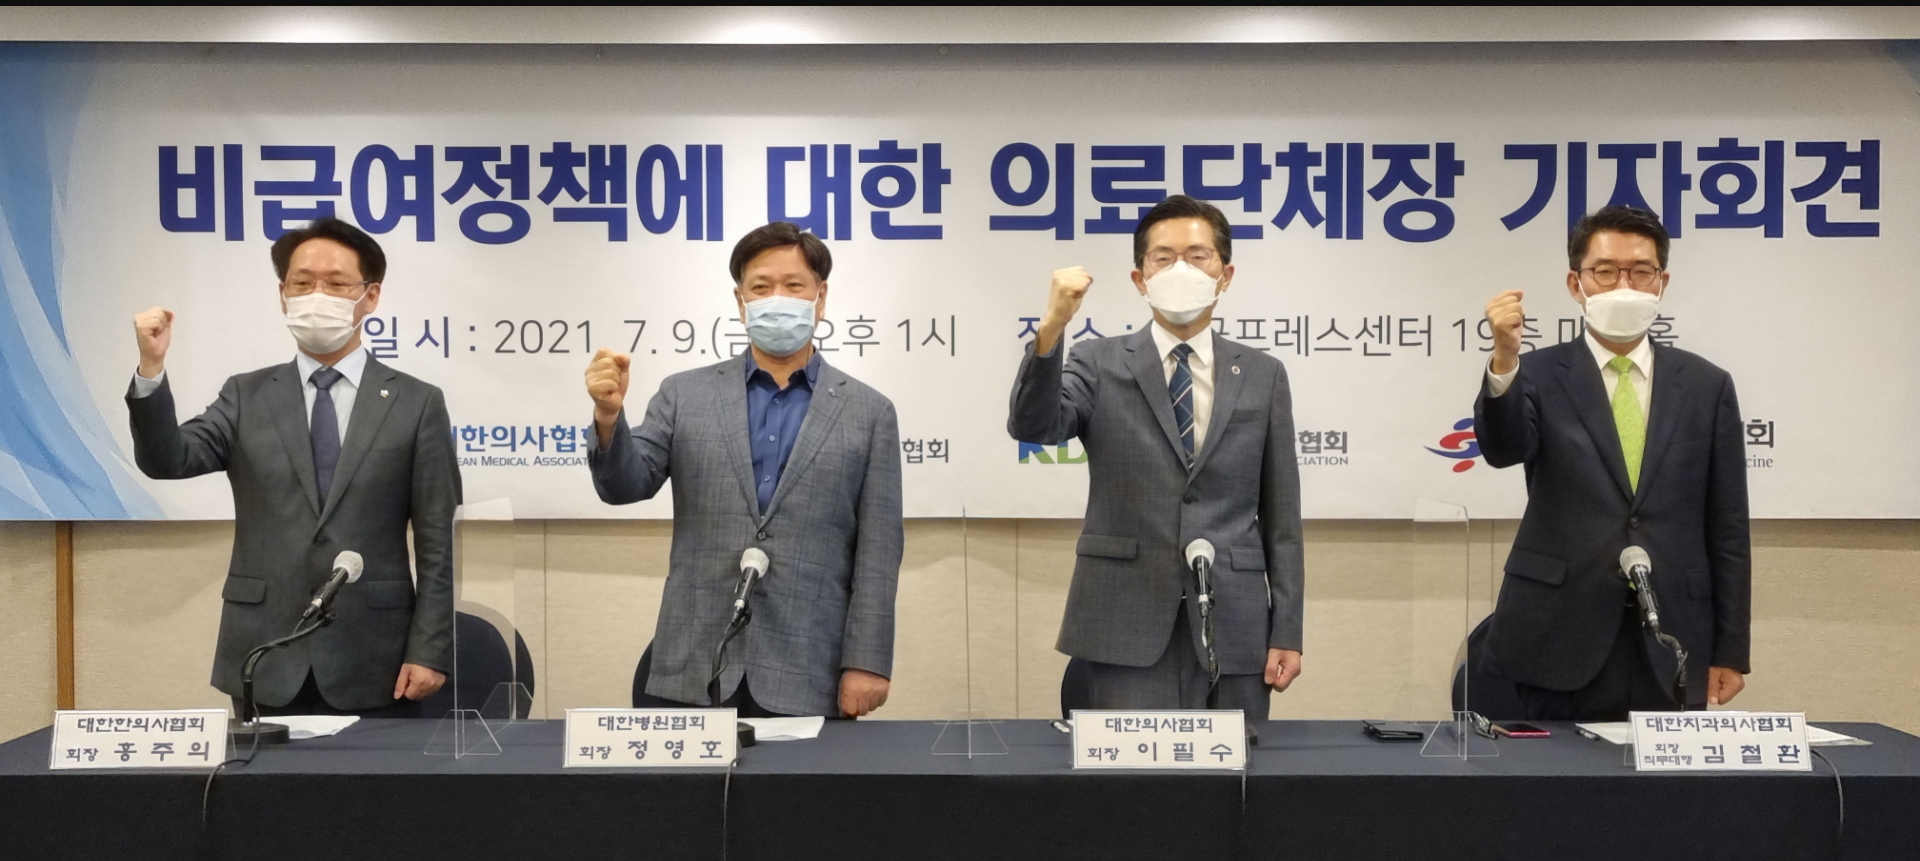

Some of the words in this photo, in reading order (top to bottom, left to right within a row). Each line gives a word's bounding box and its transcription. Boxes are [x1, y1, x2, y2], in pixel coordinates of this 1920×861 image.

[158, 142, 723, 244] 비급여정책에
[766, 140, 951, 241] 대한
[989, 142, 1465, 243] 의료단체장
[1500, 137, 1881, 239] 기자회견
[415, 316, 449, 358] 시
[623, 319, 657, 354] 7.
[897, 314, 956, 357] 1시
[1297, 429, 1349, 454] 협회
[533, 454, 589, 467] ASSOCIAT
[77, 716, 205, 733] 대한한의사협회
[598, 715, 705, 731] 대한병원협회
[1105, 717, 1213, 733] 대한의사협회
[1645, 716, 1793, 733] 대한치과의사협회
[65, 747, 99, 762] 회장
[579, 745, 612, 760] 회장
[1087, 747, 1120, 761] 회장
[1655, 743, 1679, 754] 회장
